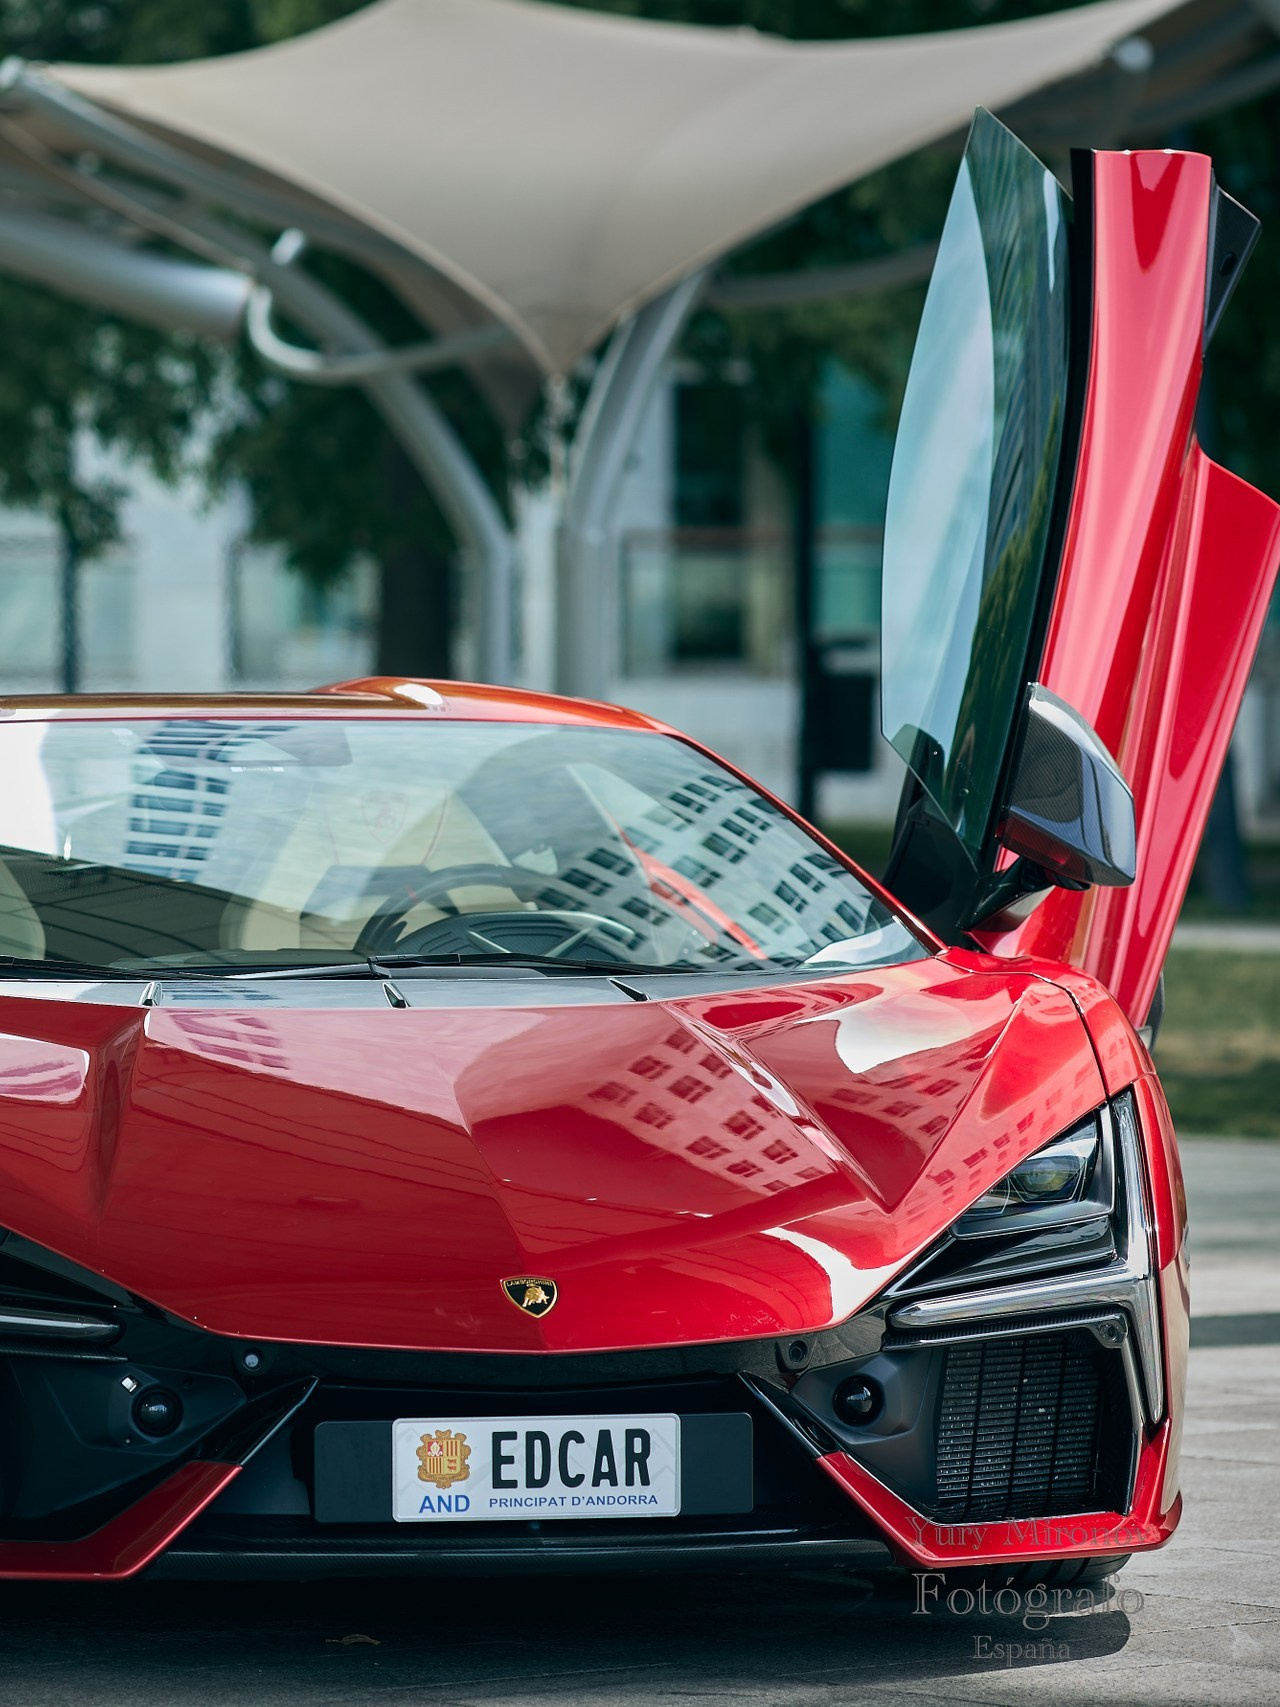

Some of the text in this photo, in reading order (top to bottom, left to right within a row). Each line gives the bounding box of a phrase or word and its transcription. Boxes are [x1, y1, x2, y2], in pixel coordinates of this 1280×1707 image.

[491, 1428, 651, 1490] EDCAR
[419, 1494, 471, 1514] AND
[489, 1493, 659, 1509] PRINCIPAT D'ANDORRA
